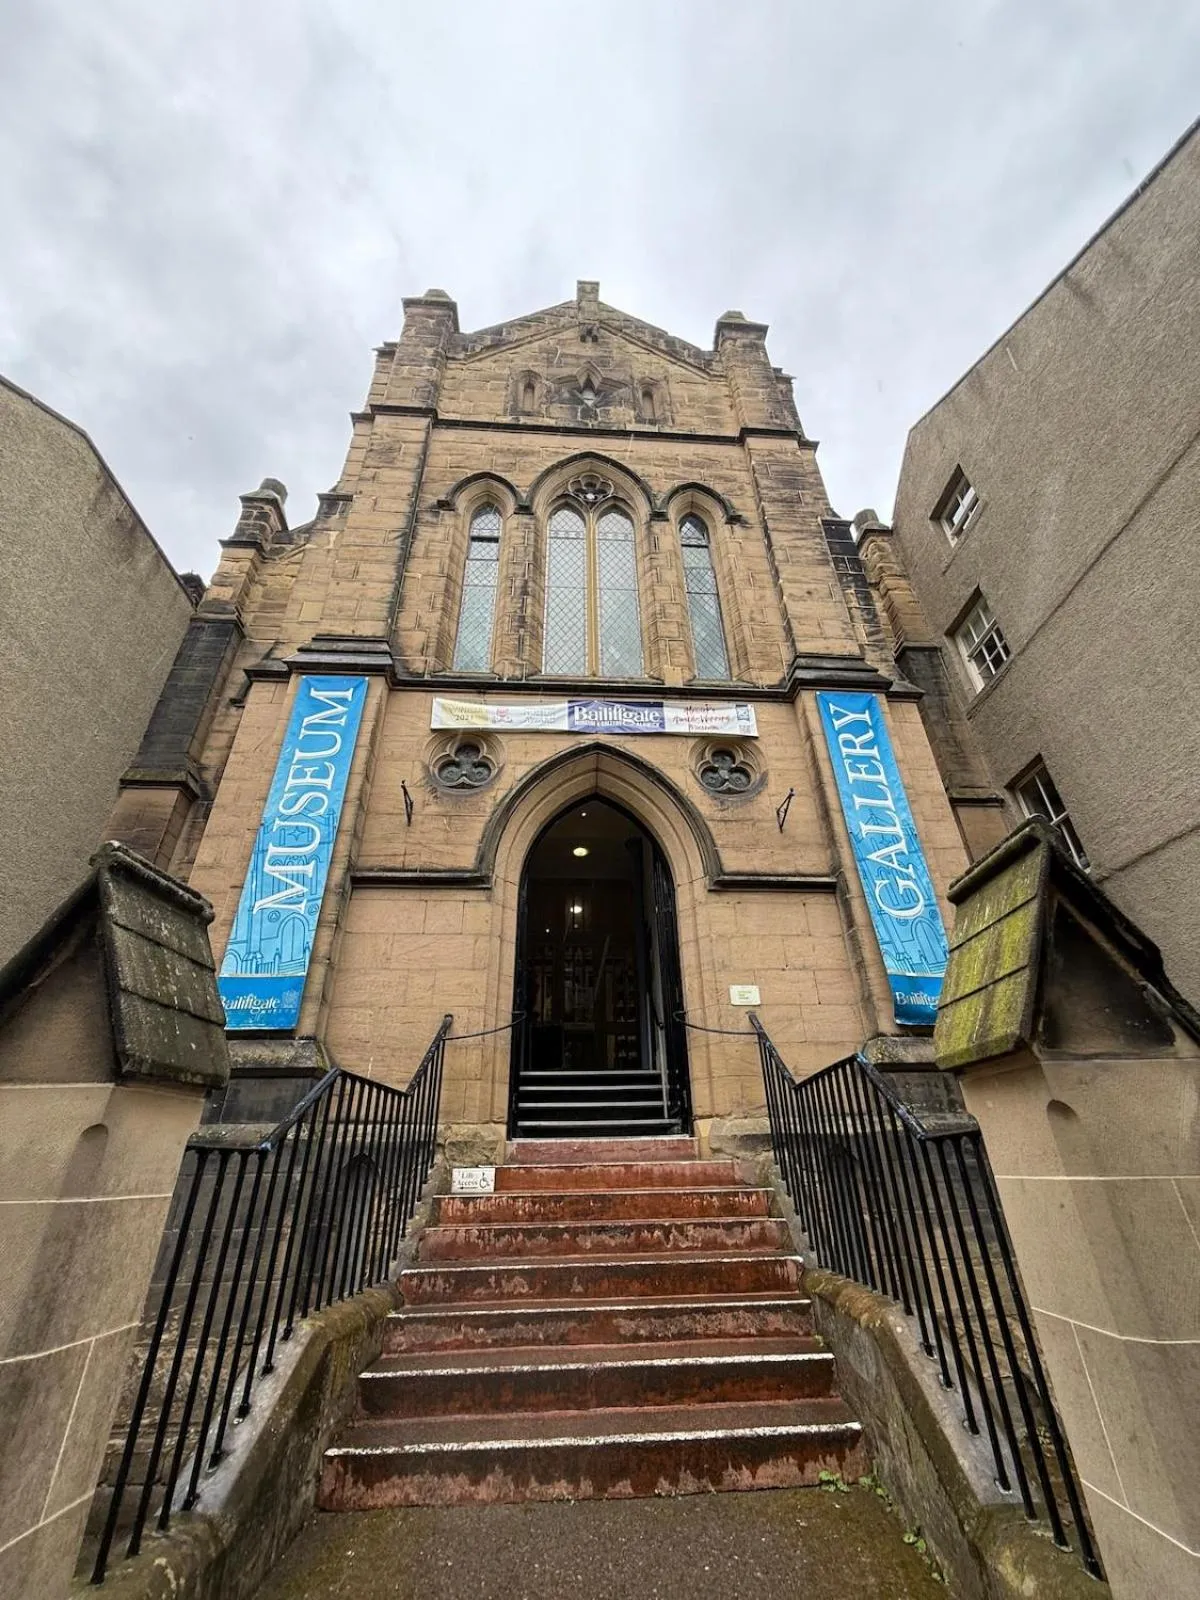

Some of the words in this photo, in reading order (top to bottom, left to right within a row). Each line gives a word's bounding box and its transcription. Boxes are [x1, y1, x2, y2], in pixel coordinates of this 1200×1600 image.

[253, 687, 354, 916] MUSEUM
[574, 704, 660, 727] Bailiffgate
[828, 702, 926, 919] GALLERY
